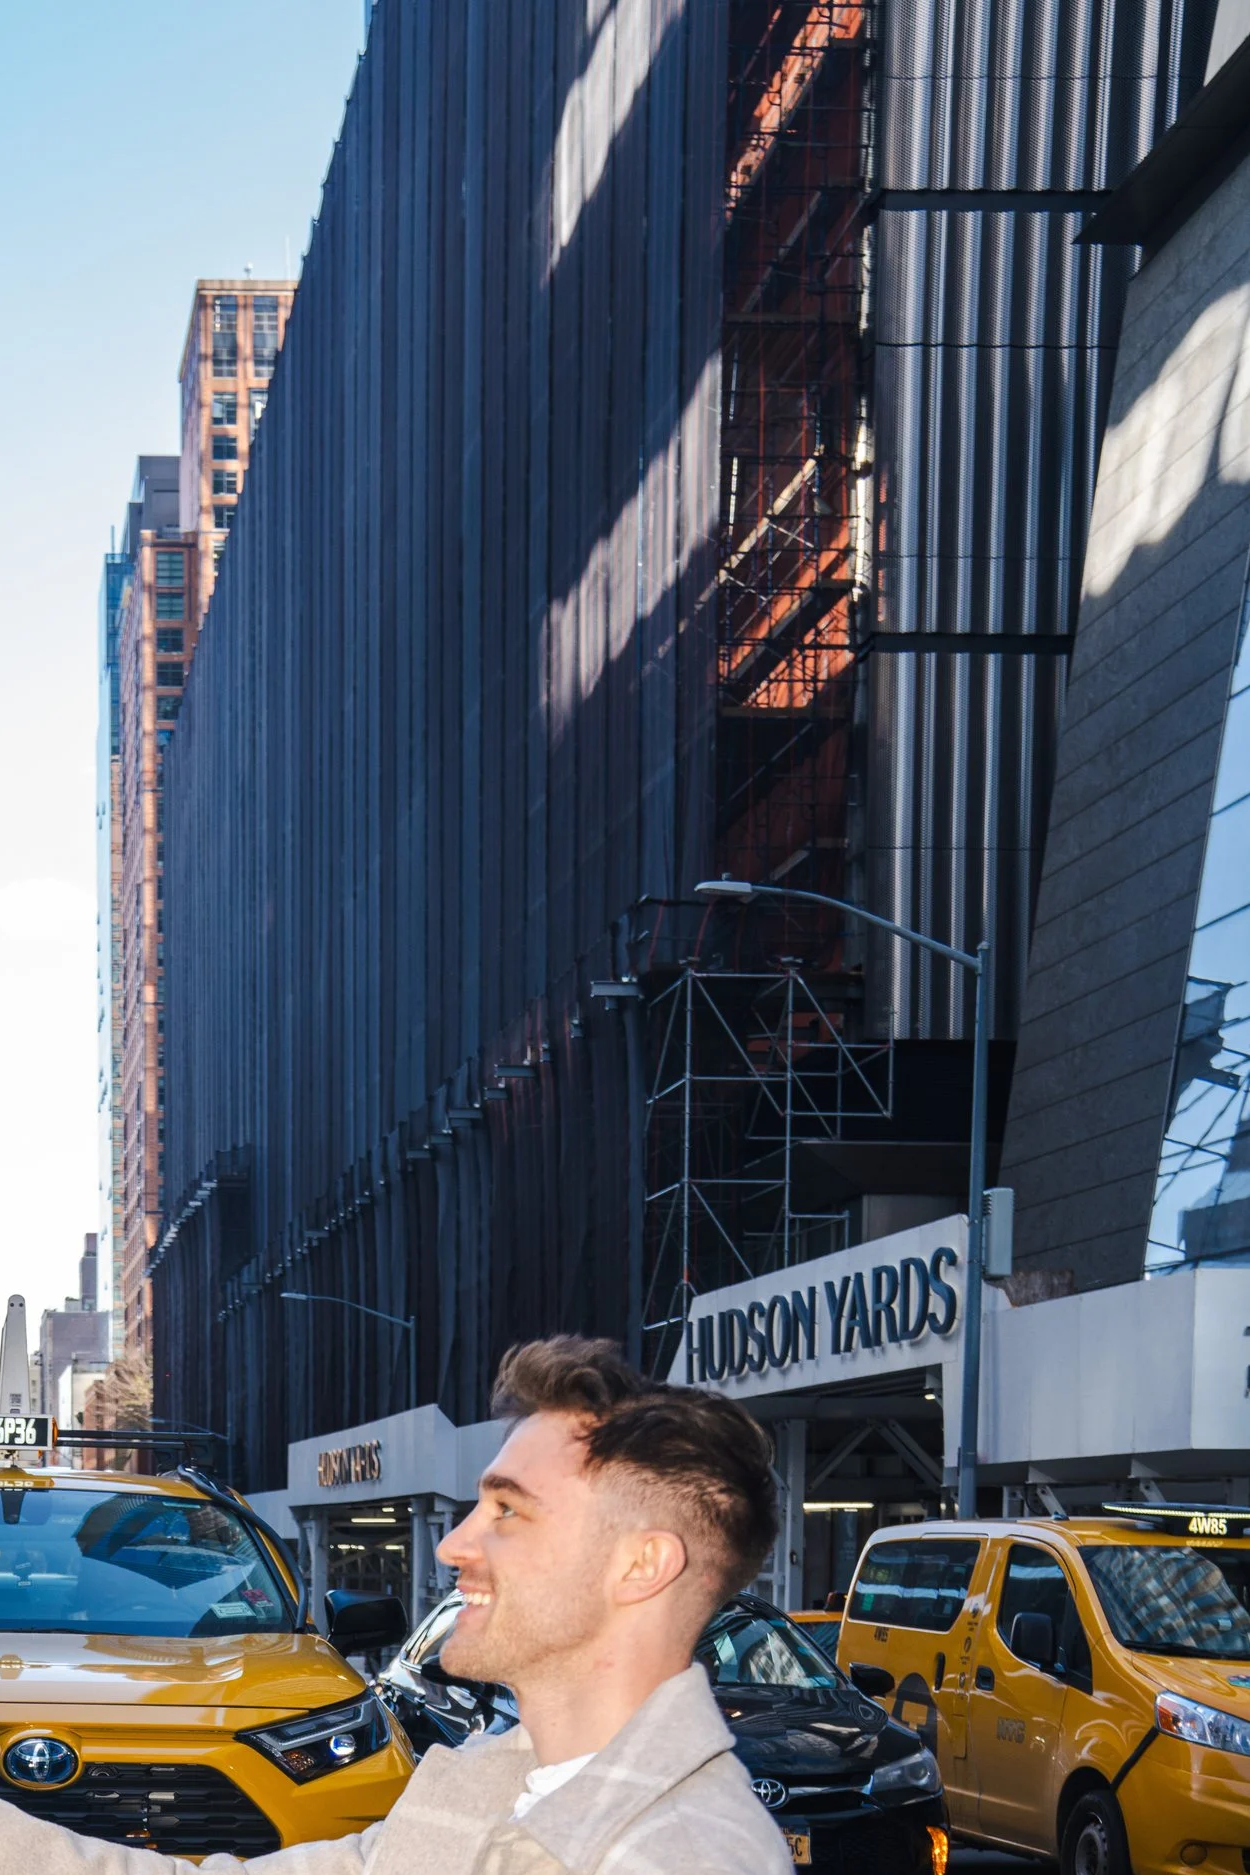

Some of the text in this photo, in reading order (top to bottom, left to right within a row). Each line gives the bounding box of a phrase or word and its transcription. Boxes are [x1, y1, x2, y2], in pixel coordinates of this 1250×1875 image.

[686, 1246, 958, 1384] HUDSON YARDS
[1188, 1516, 1228, 1535] 4W85
